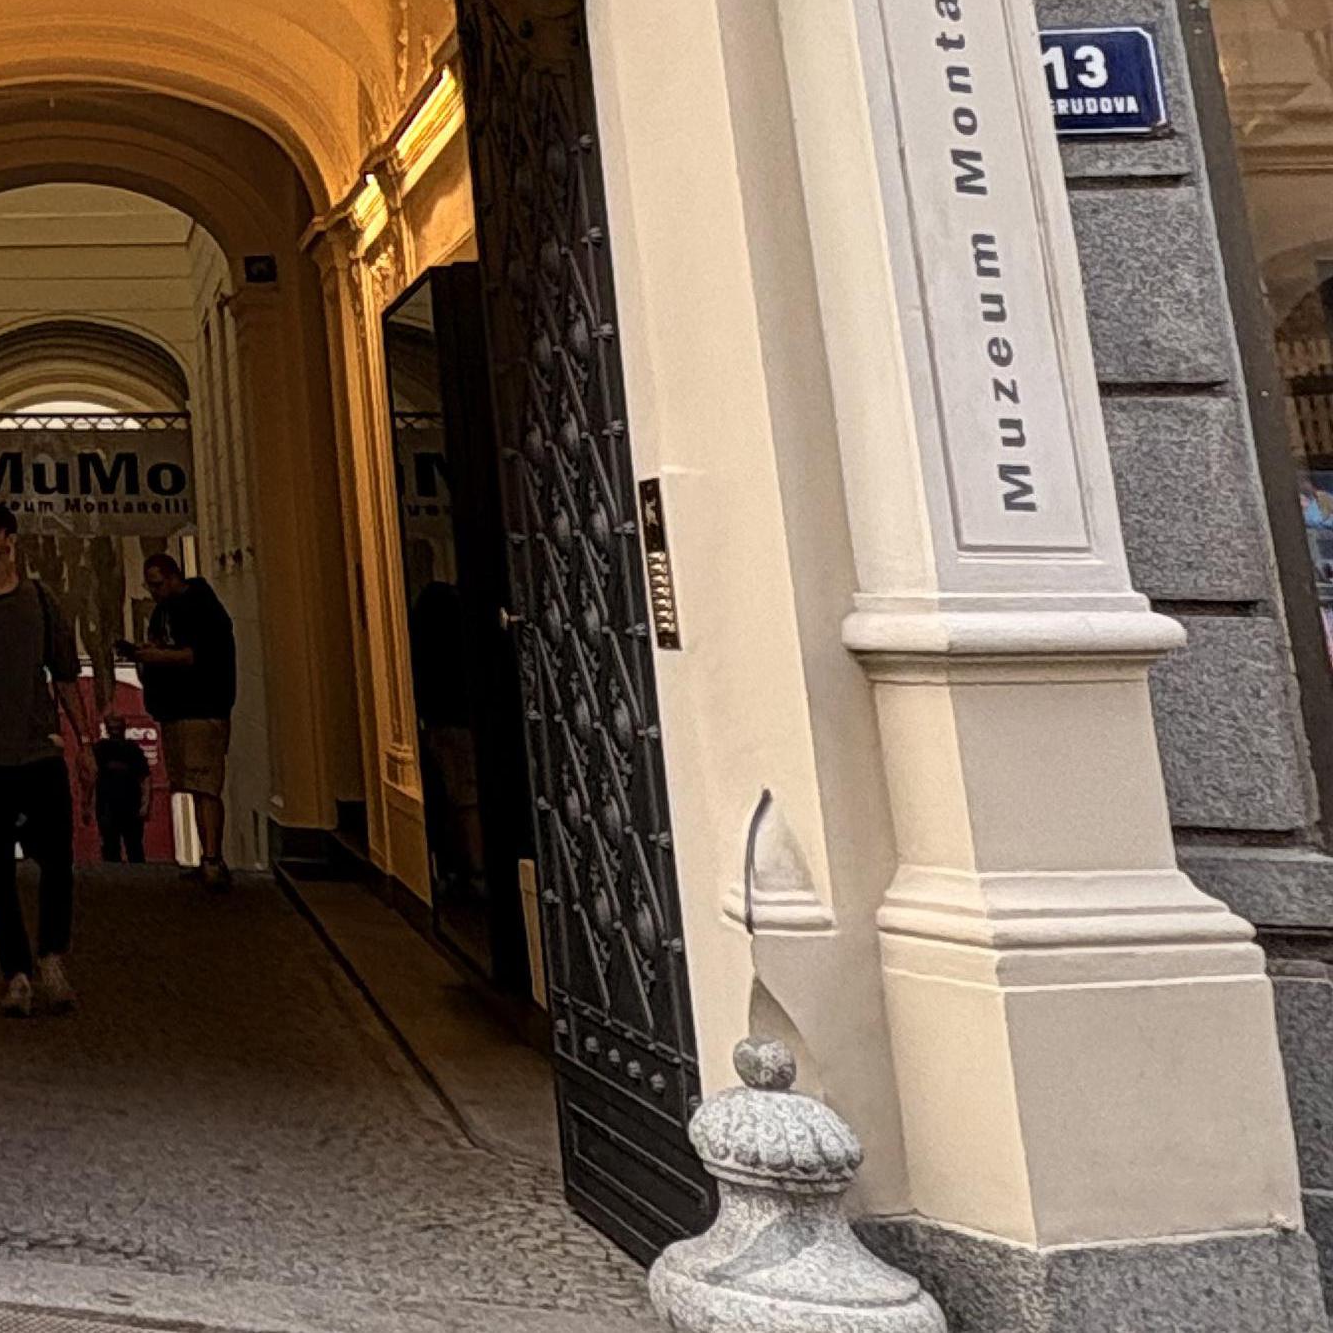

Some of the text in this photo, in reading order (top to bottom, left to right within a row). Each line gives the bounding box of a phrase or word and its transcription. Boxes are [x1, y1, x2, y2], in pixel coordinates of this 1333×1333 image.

[1041, 45, 1108, 90] 13
[969, 232, 1036, 513] Muzeum
[64, 497, 190, 515] Montanelli
